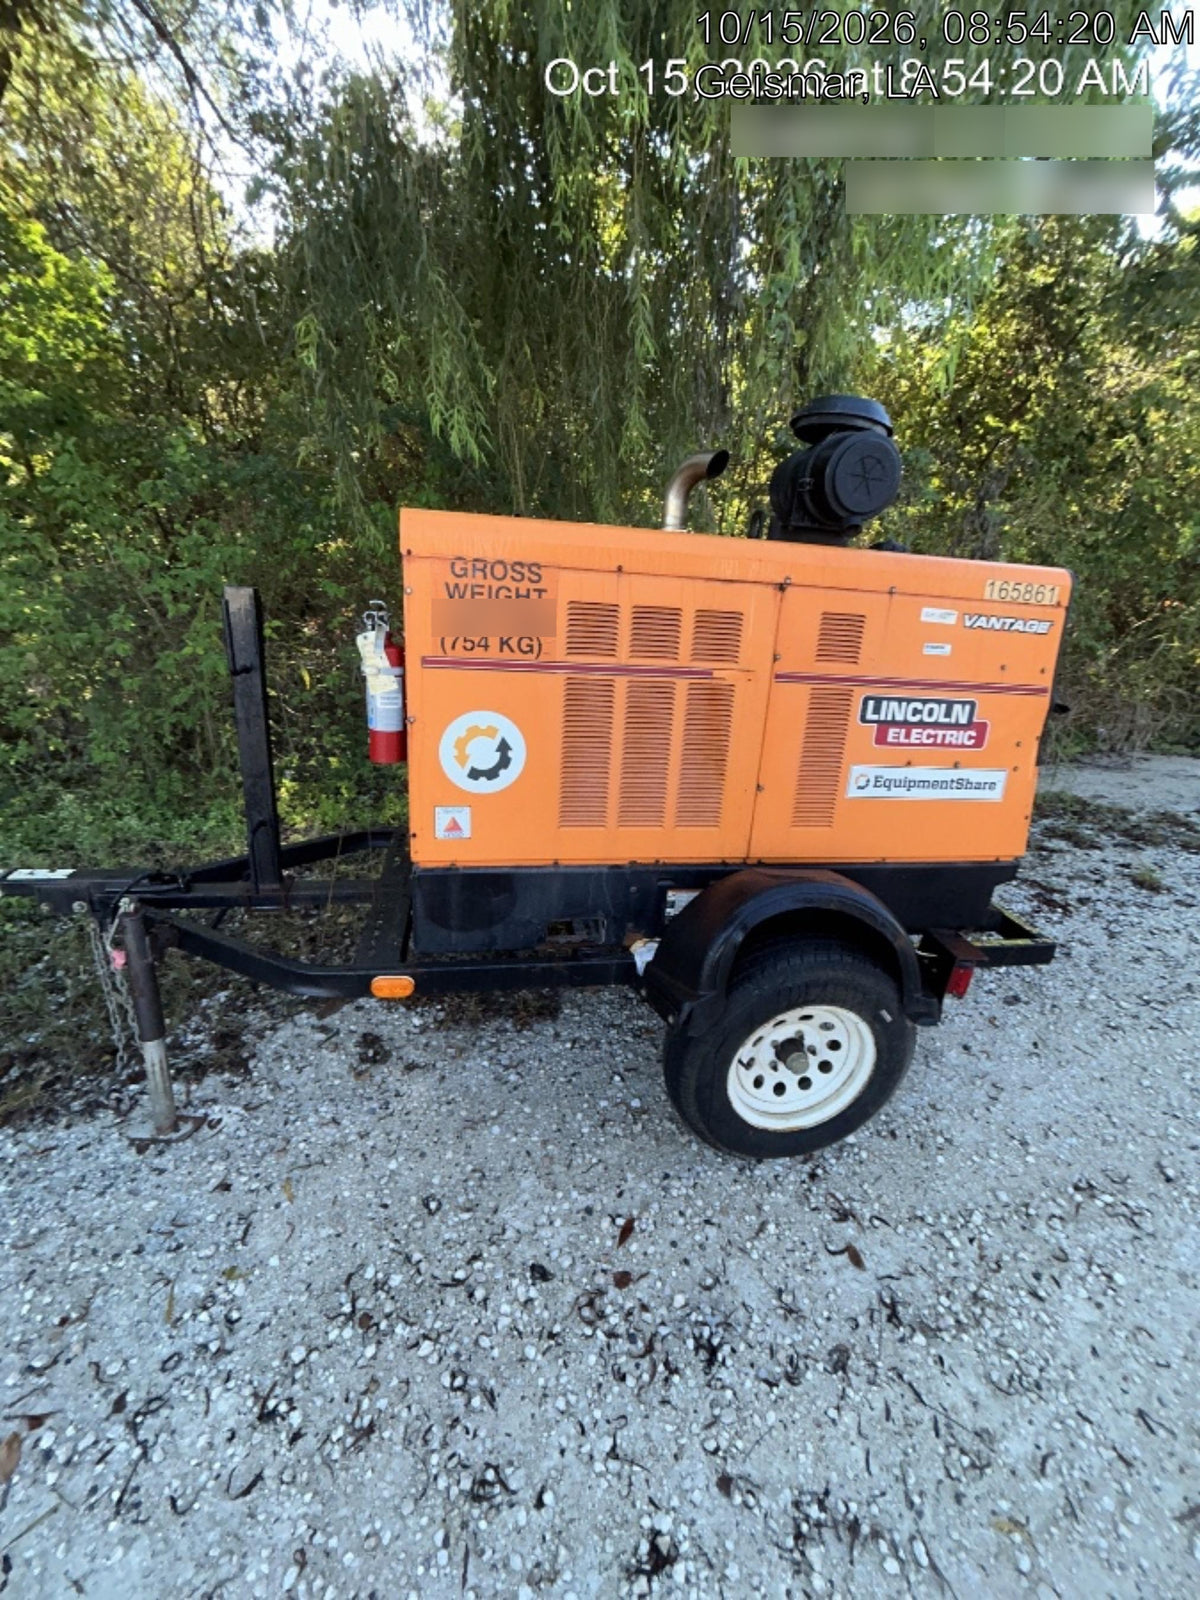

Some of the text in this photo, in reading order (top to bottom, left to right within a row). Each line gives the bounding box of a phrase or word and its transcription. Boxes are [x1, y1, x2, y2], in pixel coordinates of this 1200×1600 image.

[450, 556, 542, 583] GROSS
[986, 580, 1057, 603] 165861
[963, 613, 1053, 634] VANTAGE
[498, 637, 543, 660] KG)
[865, 699, 971, 725] LINCOLN
[886, 728, 977, 746] ELECTRIC
[872, 775, 997, 792] EquipmentShare
